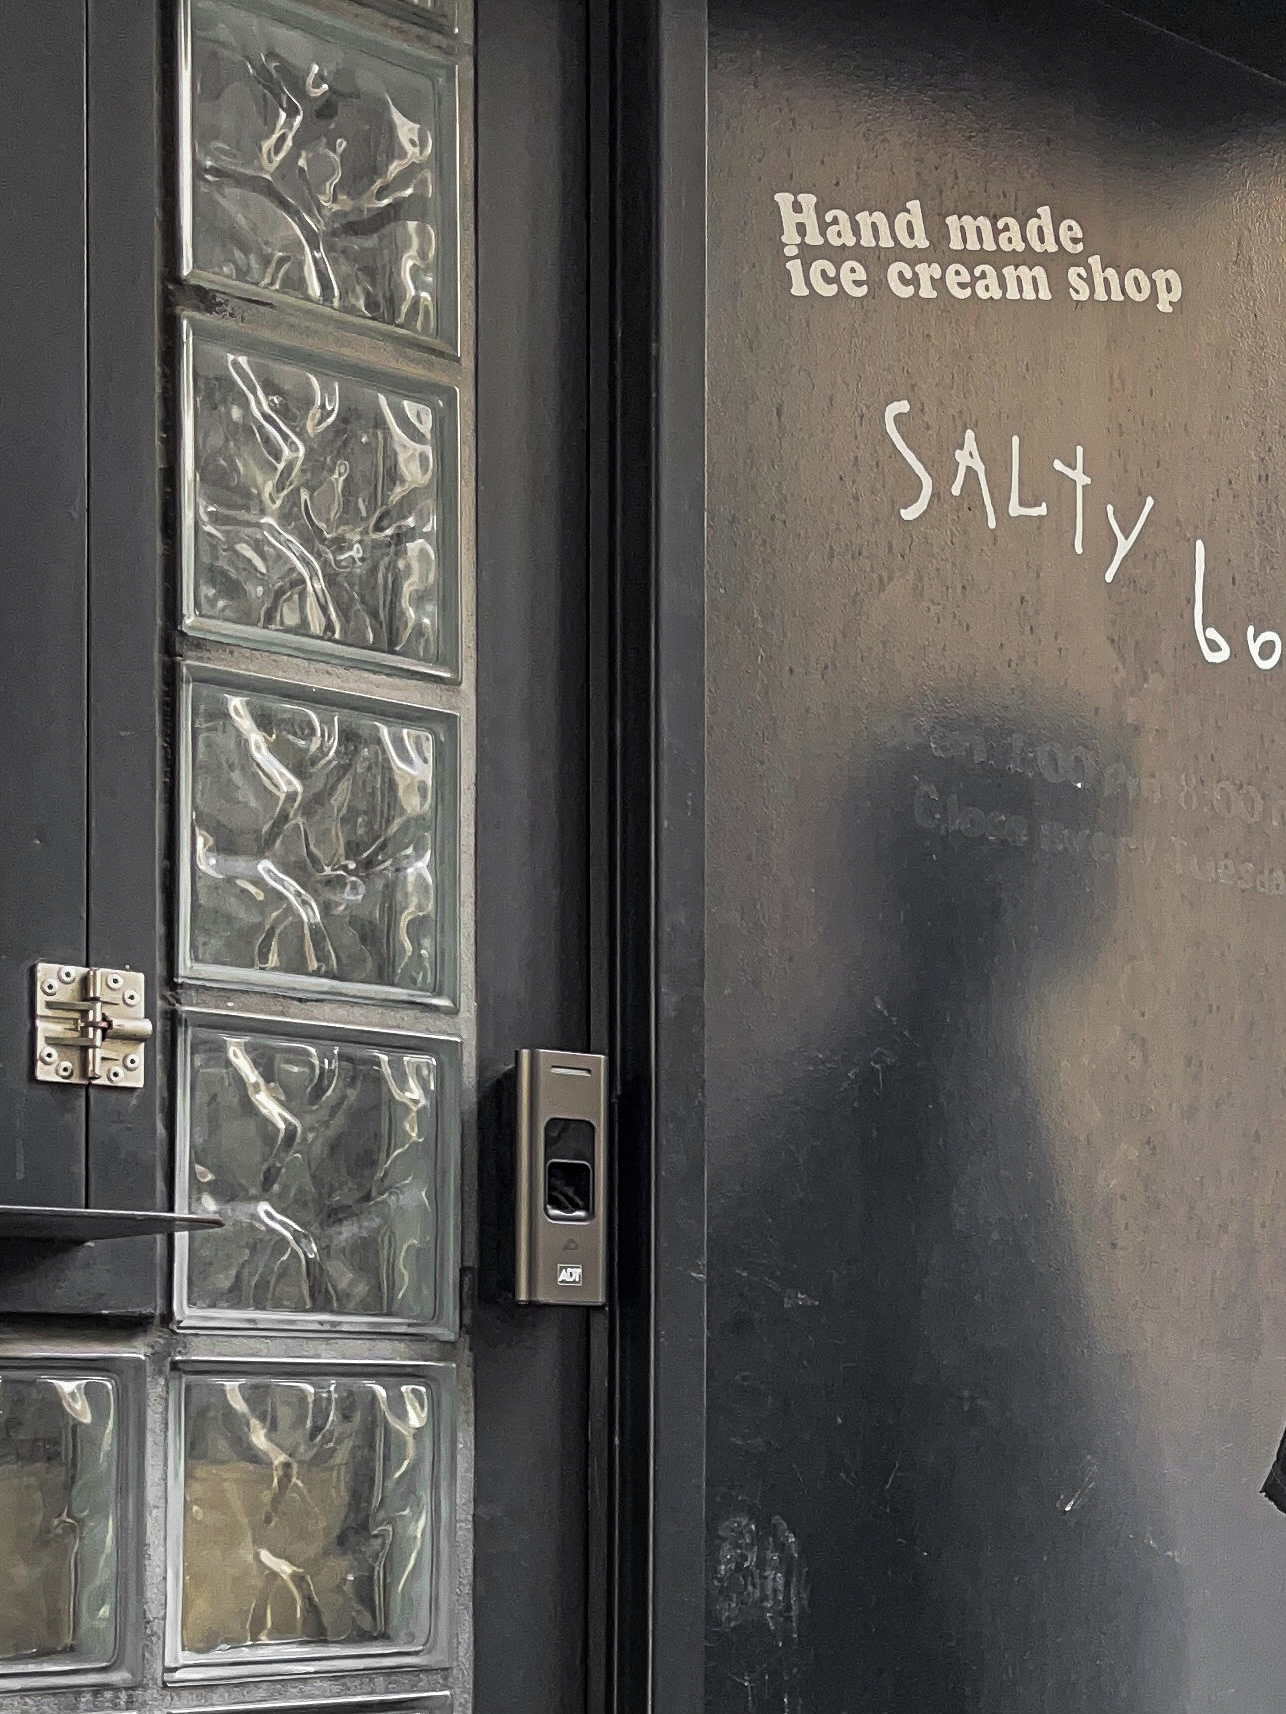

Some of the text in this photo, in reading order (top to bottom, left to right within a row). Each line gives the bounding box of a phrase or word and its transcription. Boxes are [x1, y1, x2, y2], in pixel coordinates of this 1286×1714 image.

[773, 192, 1084, 254] Hand made
[783, 244, 1183, 314] ice cream shop
[558, 1267, 583, 1282] ADT
